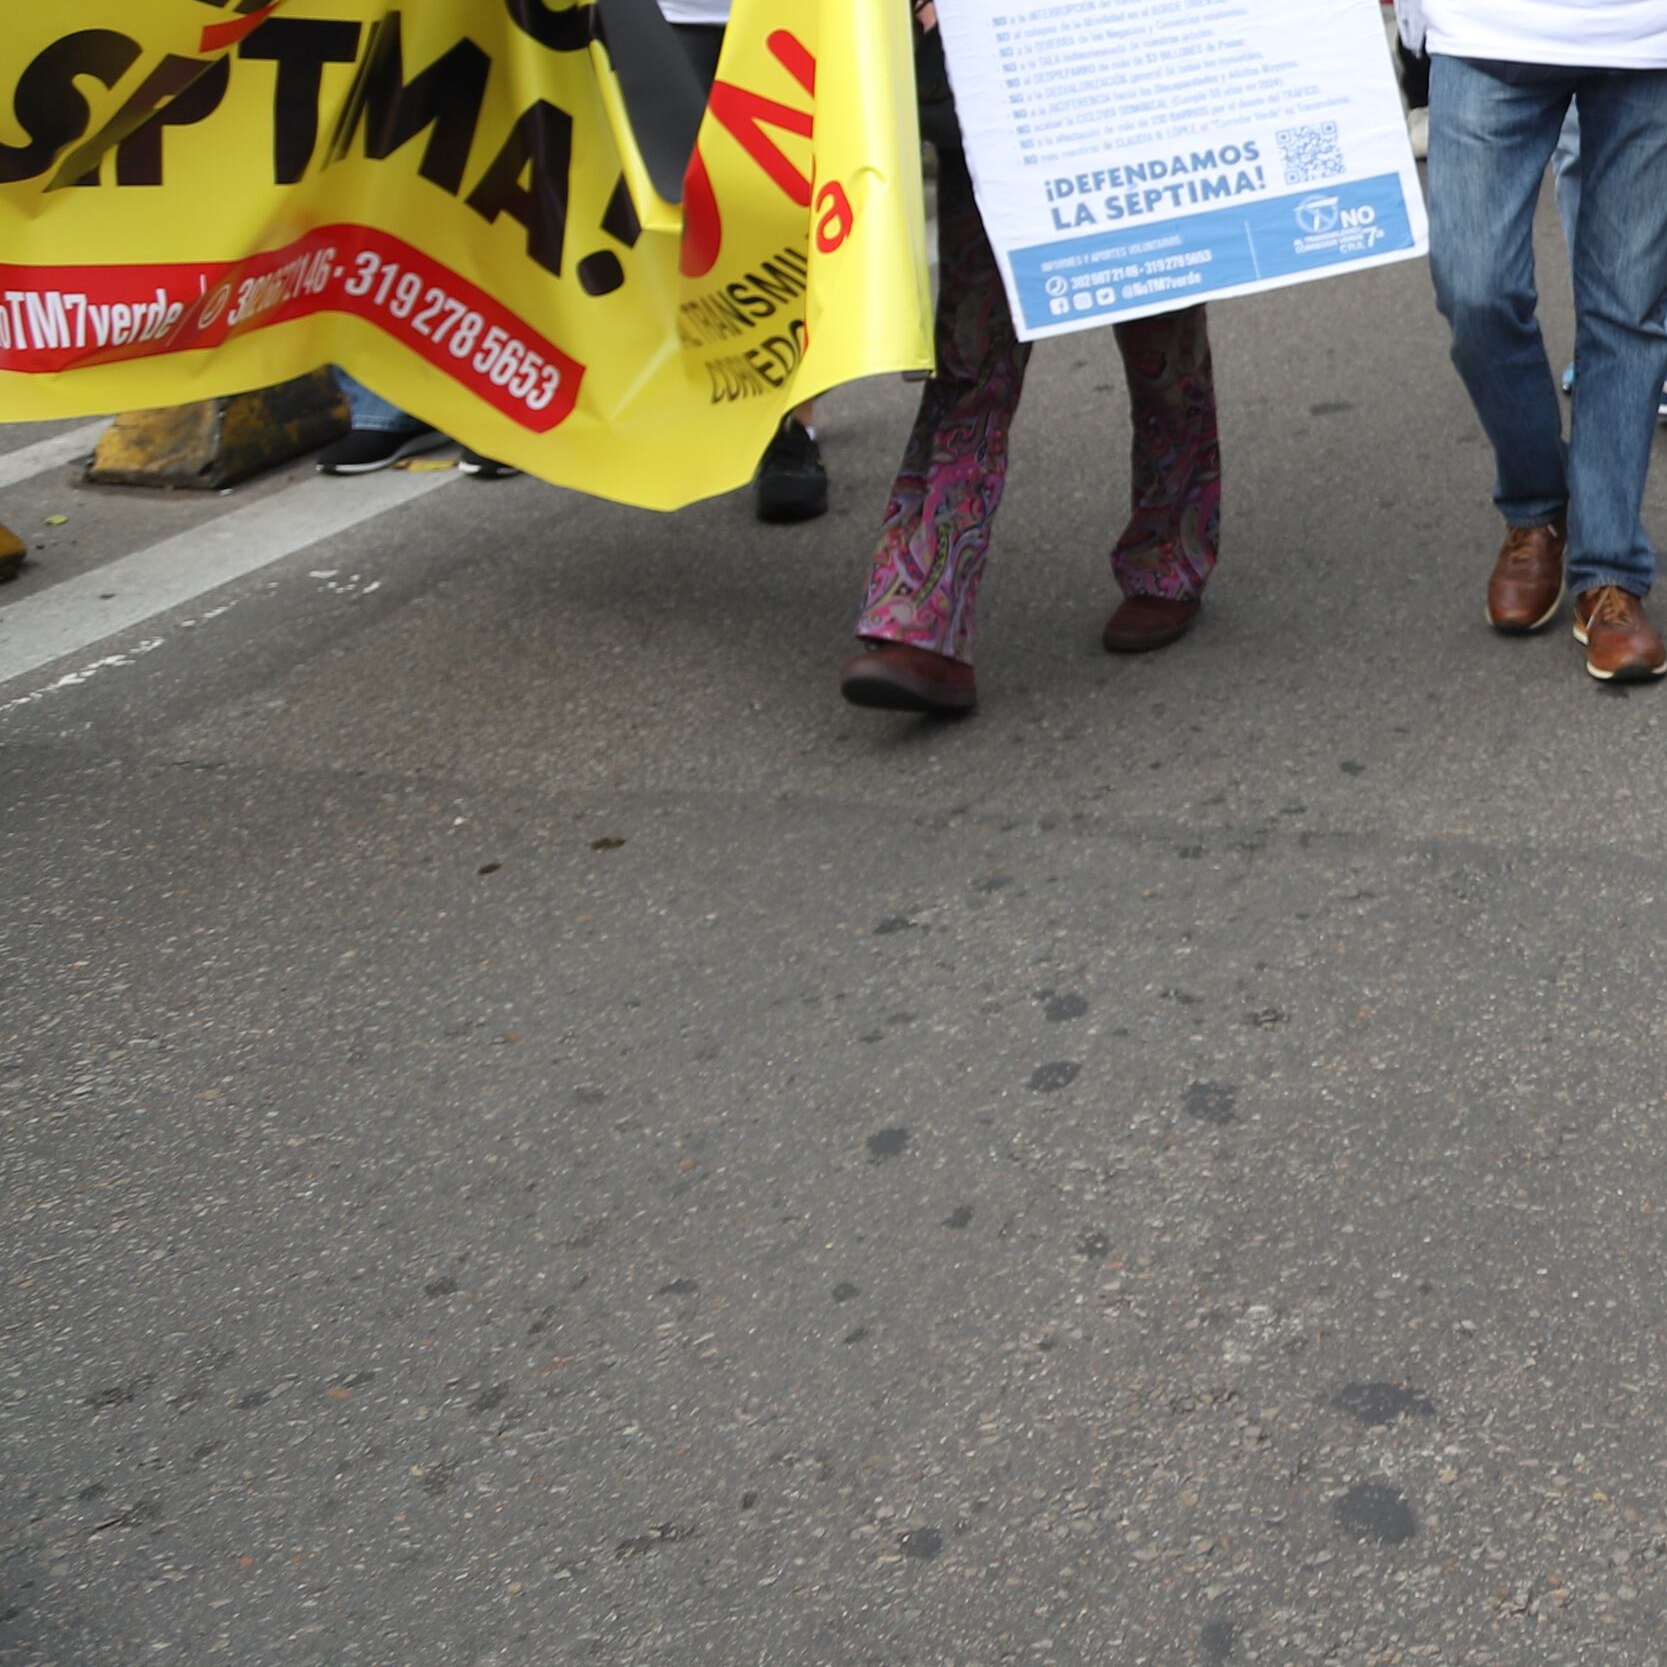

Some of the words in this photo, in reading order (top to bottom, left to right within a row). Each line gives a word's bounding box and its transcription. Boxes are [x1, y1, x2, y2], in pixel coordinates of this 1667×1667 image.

[1045, 141, 1260, 202] ¡DEFENDAMOS
[1051, 200, 1096, 230] LA
[1105, 166, 1267, 221] SÉPTIMA!
[1340, 205, 1375, 228] NO
[345, 250, 423, 319] 319
[412, 286, 486, 357] 278
[472, 327, 562, 412] 5653
